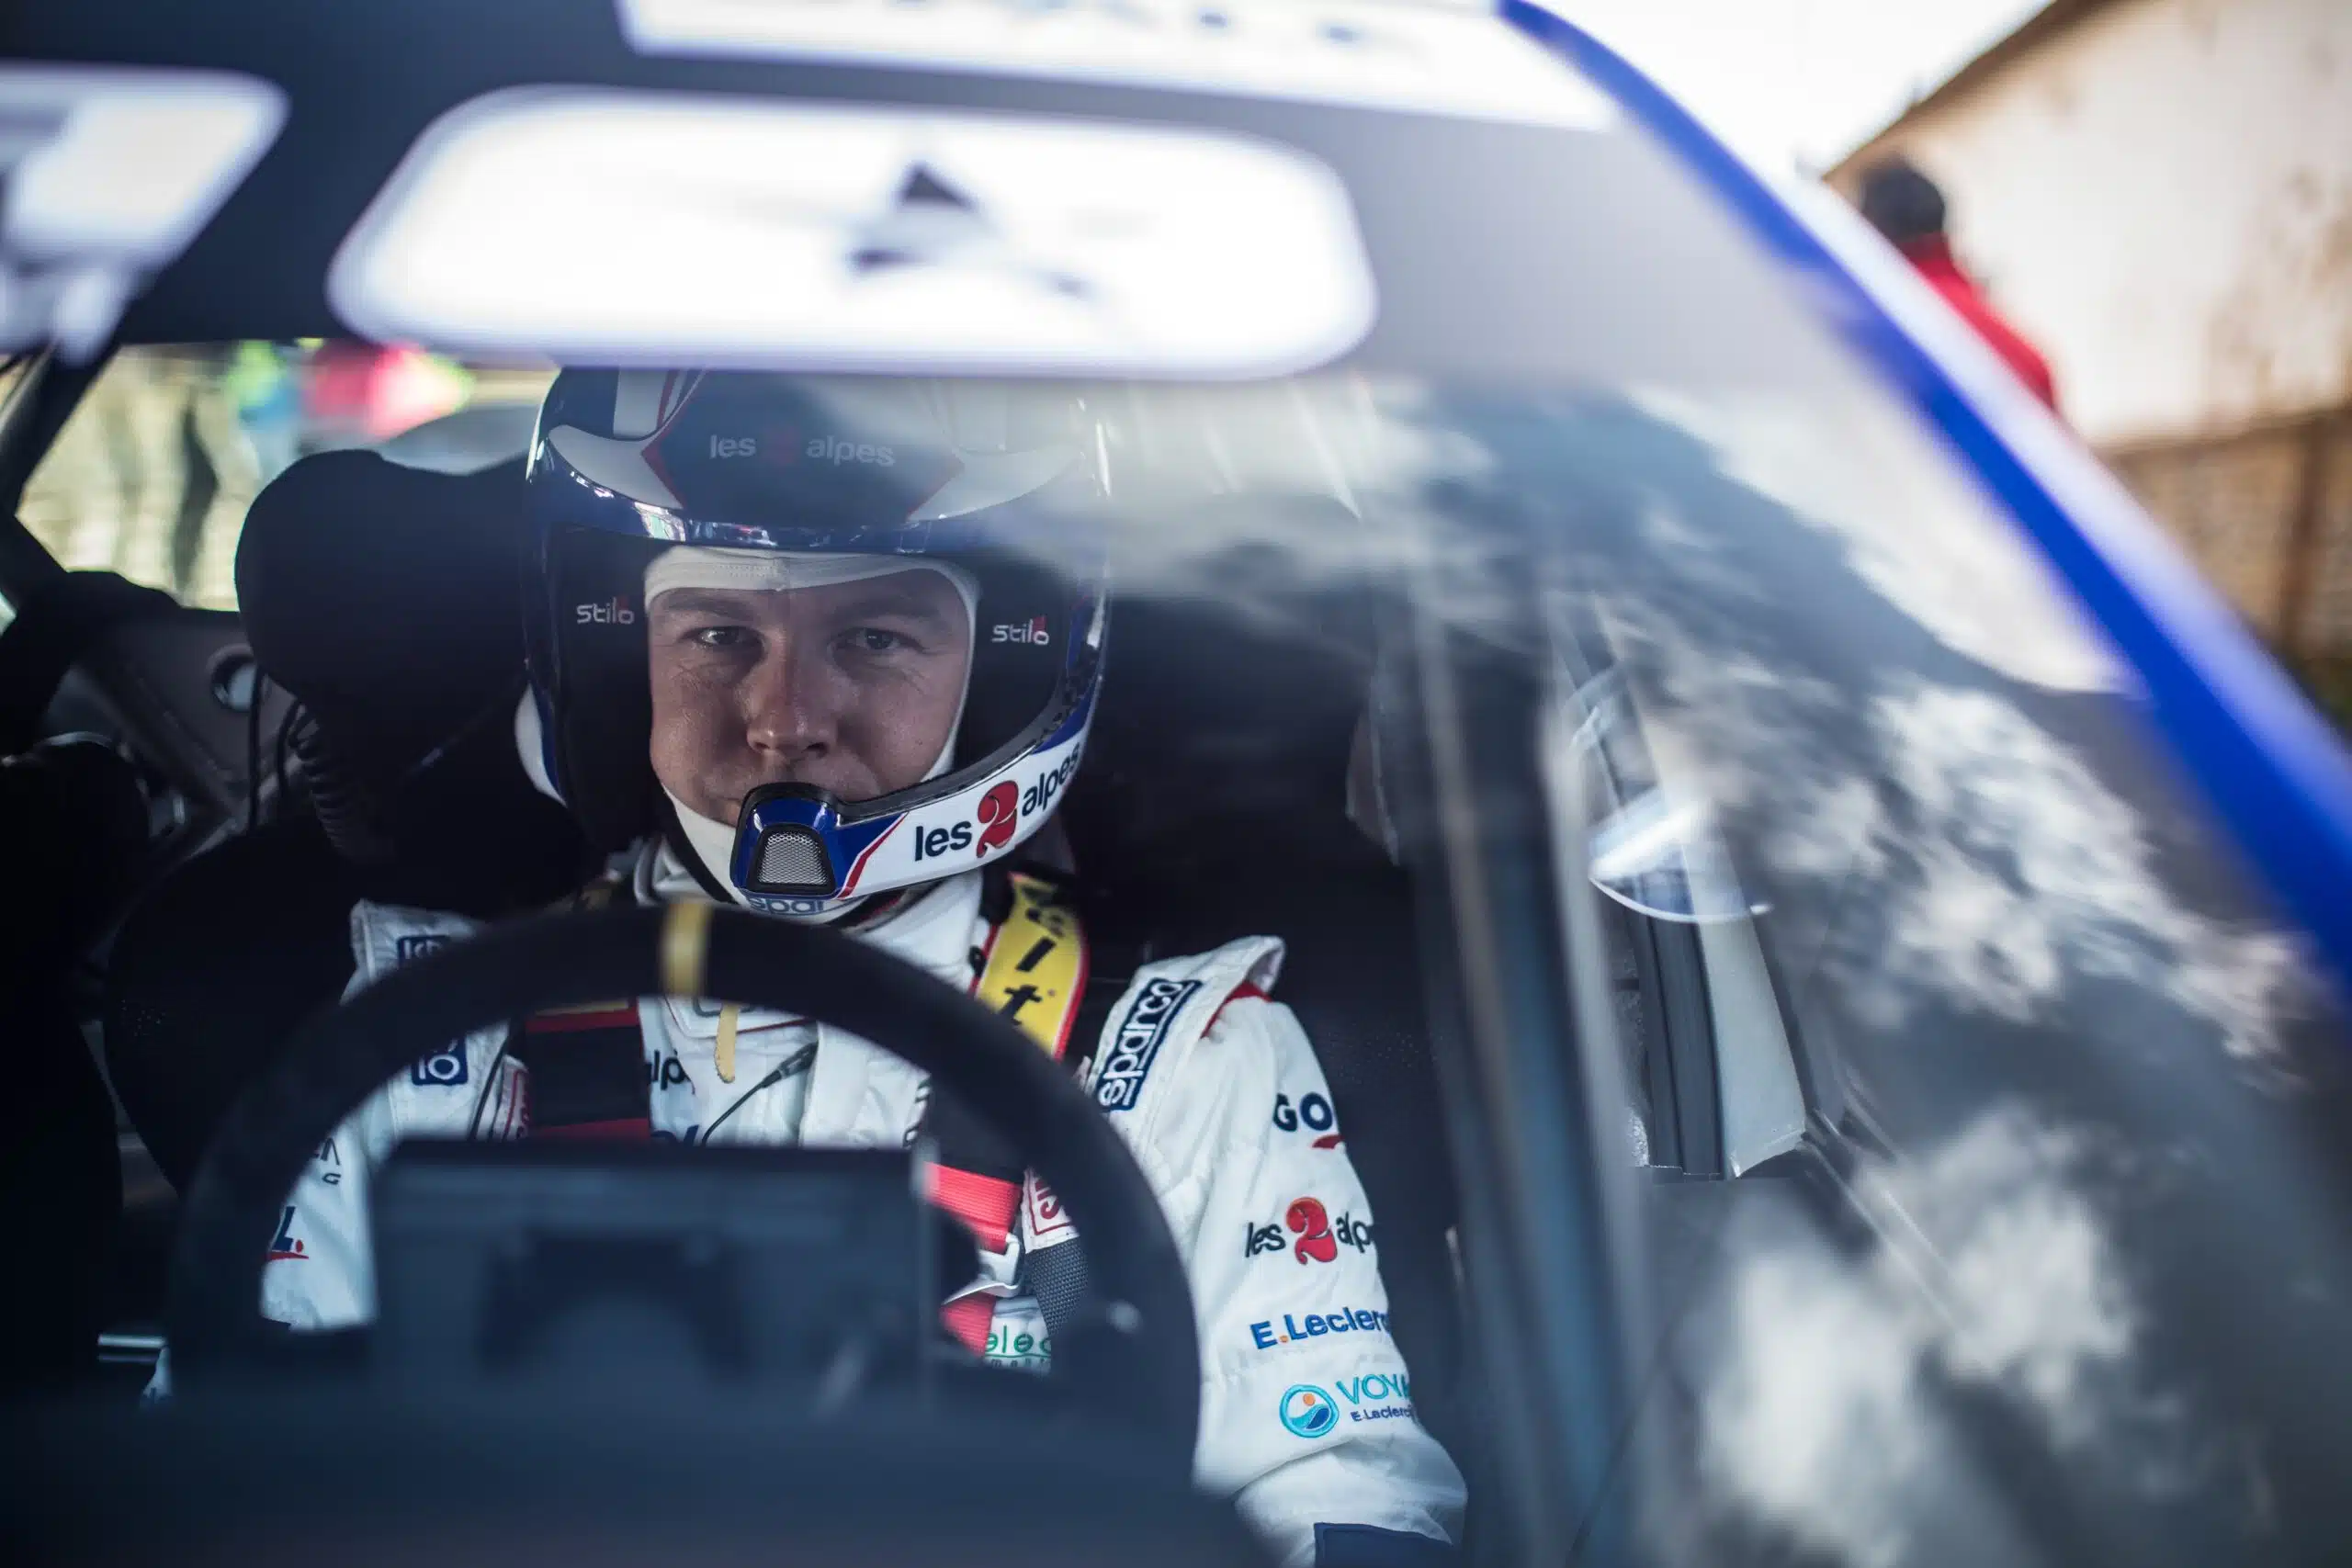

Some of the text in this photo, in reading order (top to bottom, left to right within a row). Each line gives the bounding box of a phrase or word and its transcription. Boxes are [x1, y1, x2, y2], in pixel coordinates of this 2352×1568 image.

[710, 434, 756, 458] les
[806, 435, 896, 467] alpes
[576, 597, 635, 624] stilo
[991, 618, 1049, 645] stilo
[915, 742, 1080, 862] les 2 alpes
[1098, 982, 1182, 1106] sparco
[1245, 1197, 1374, 1265] les 2 alp
